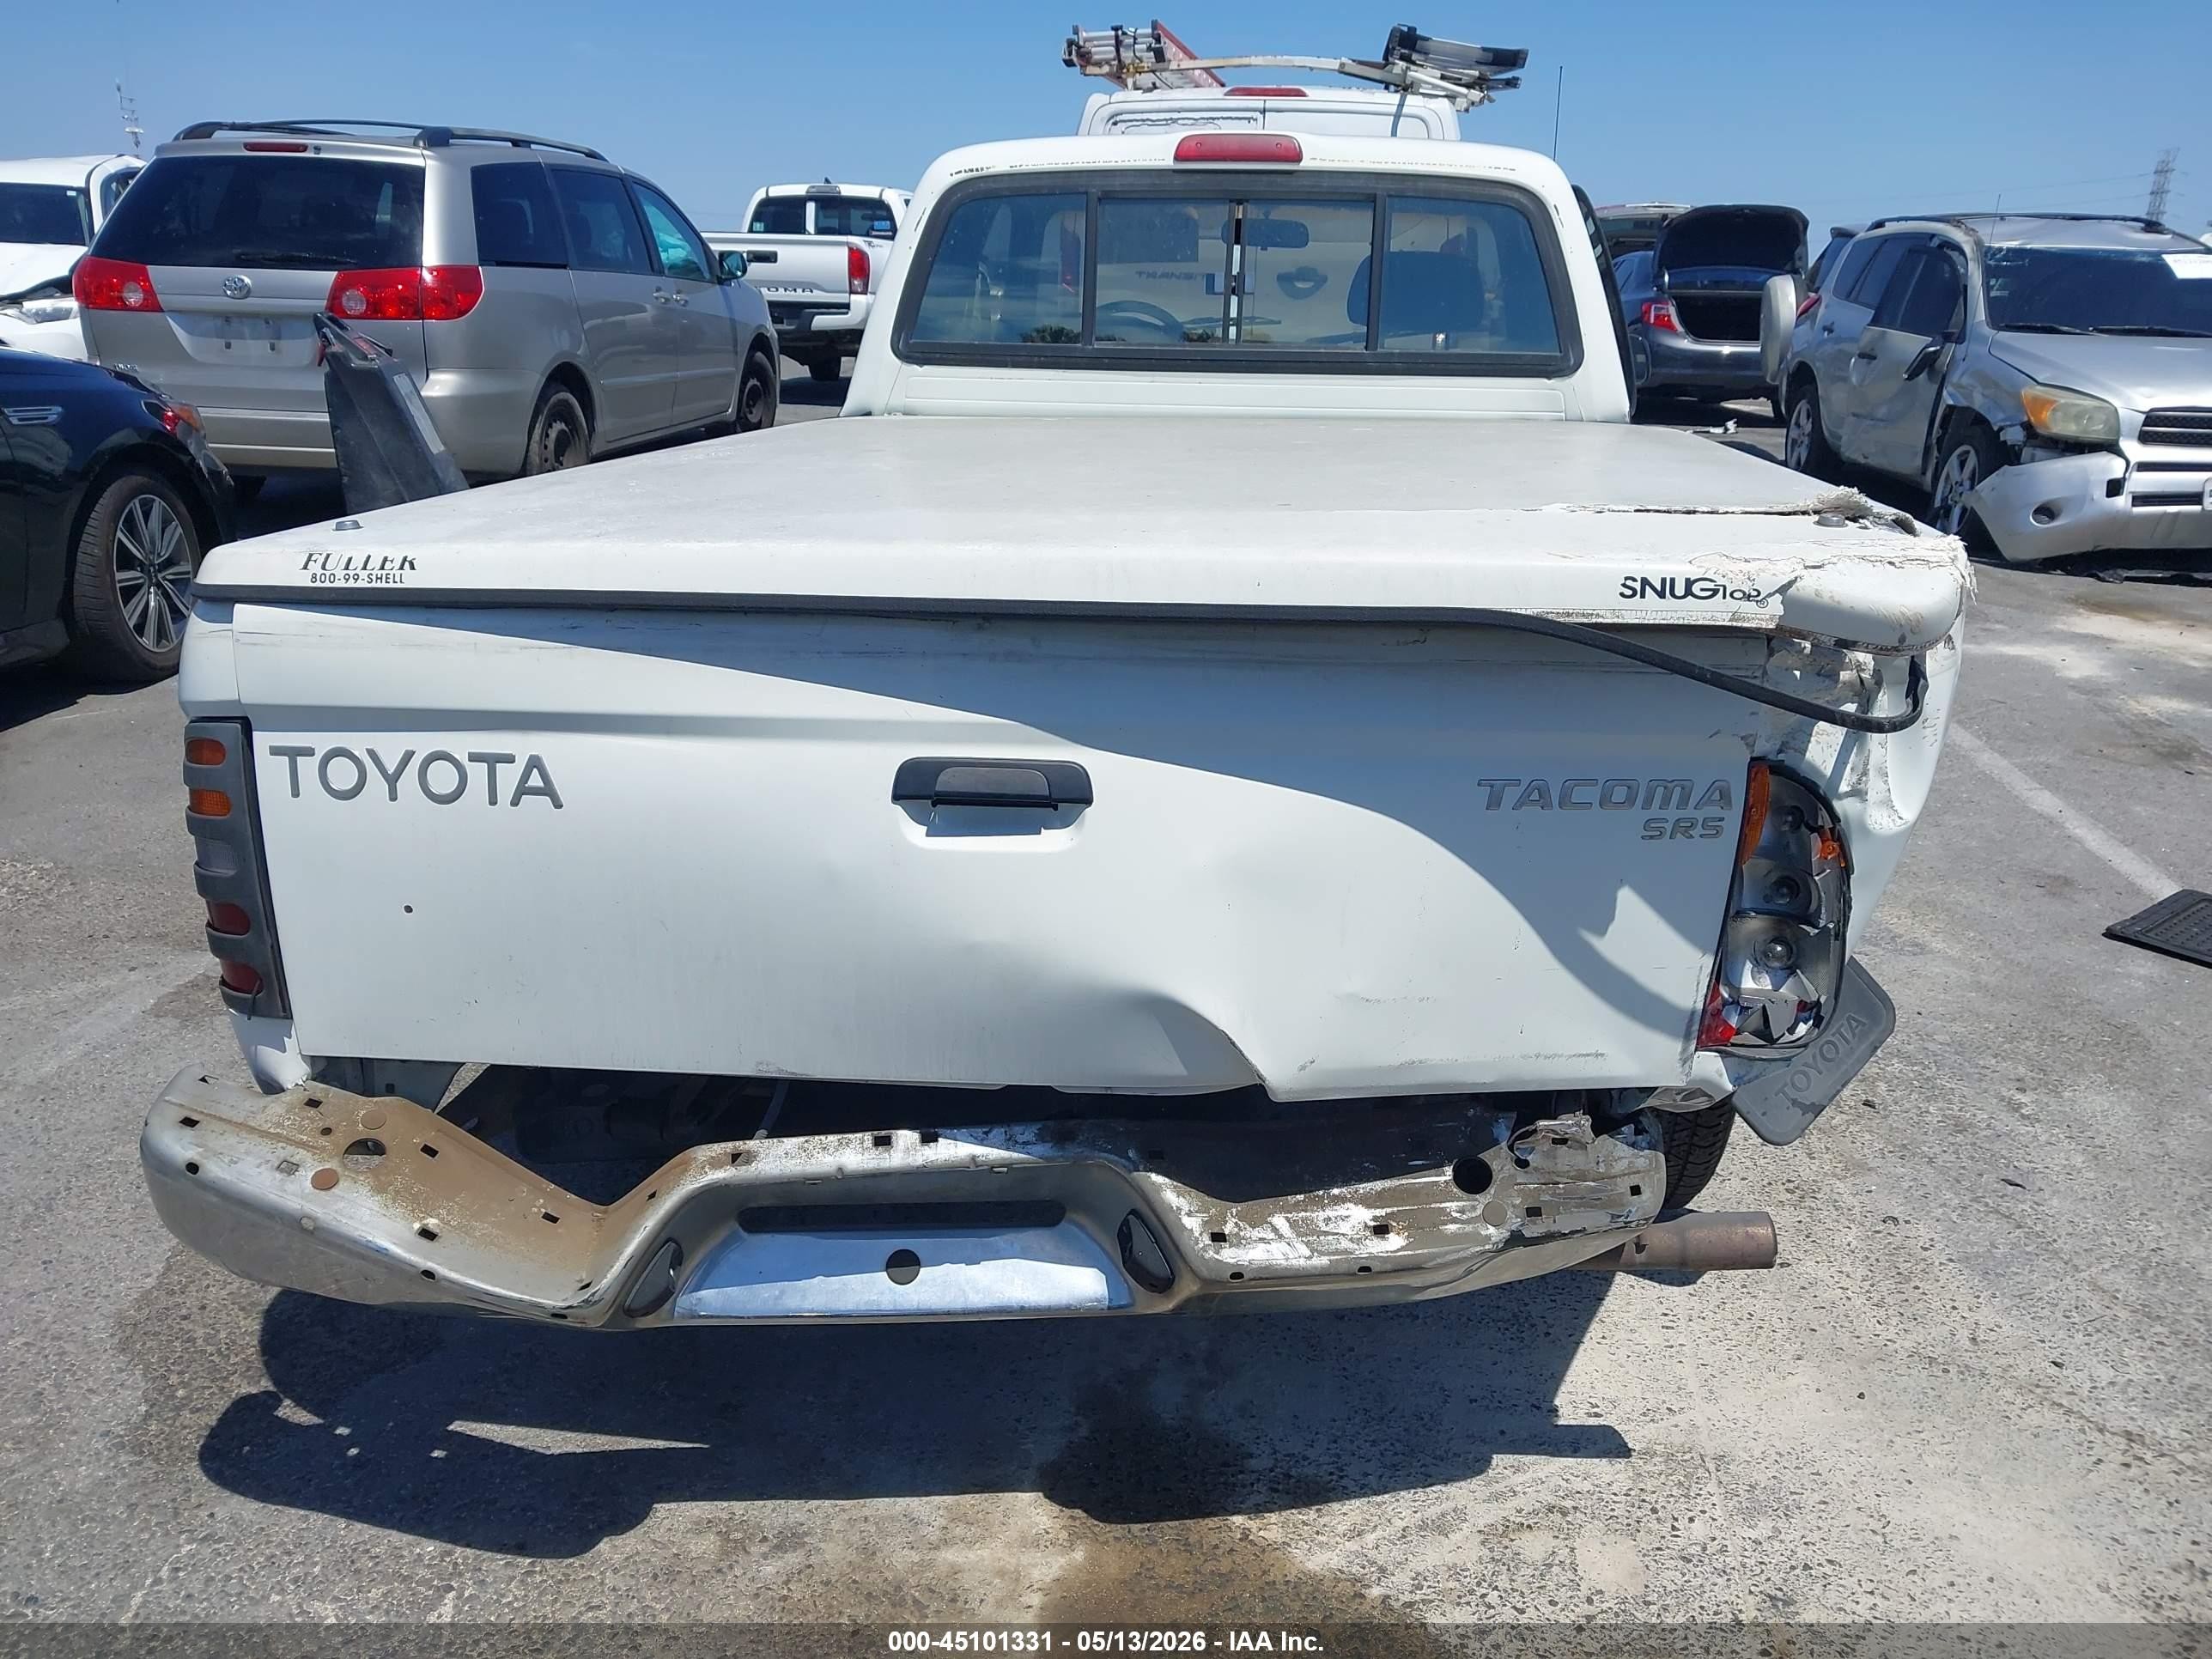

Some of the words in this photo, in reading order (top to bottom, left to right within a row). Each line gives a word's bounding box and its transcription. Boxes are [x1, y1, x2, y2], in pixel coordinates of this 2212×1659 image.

[310, 573, 404, 584] 800-99-SHELL
[269, 744, 563, 809] TOYOTA
[1477, 778, 1733, 810] TACOMA
[1641, 817, 1724, 840] SR5
[1774, 1012, 1869, 1103] TOYOTA
